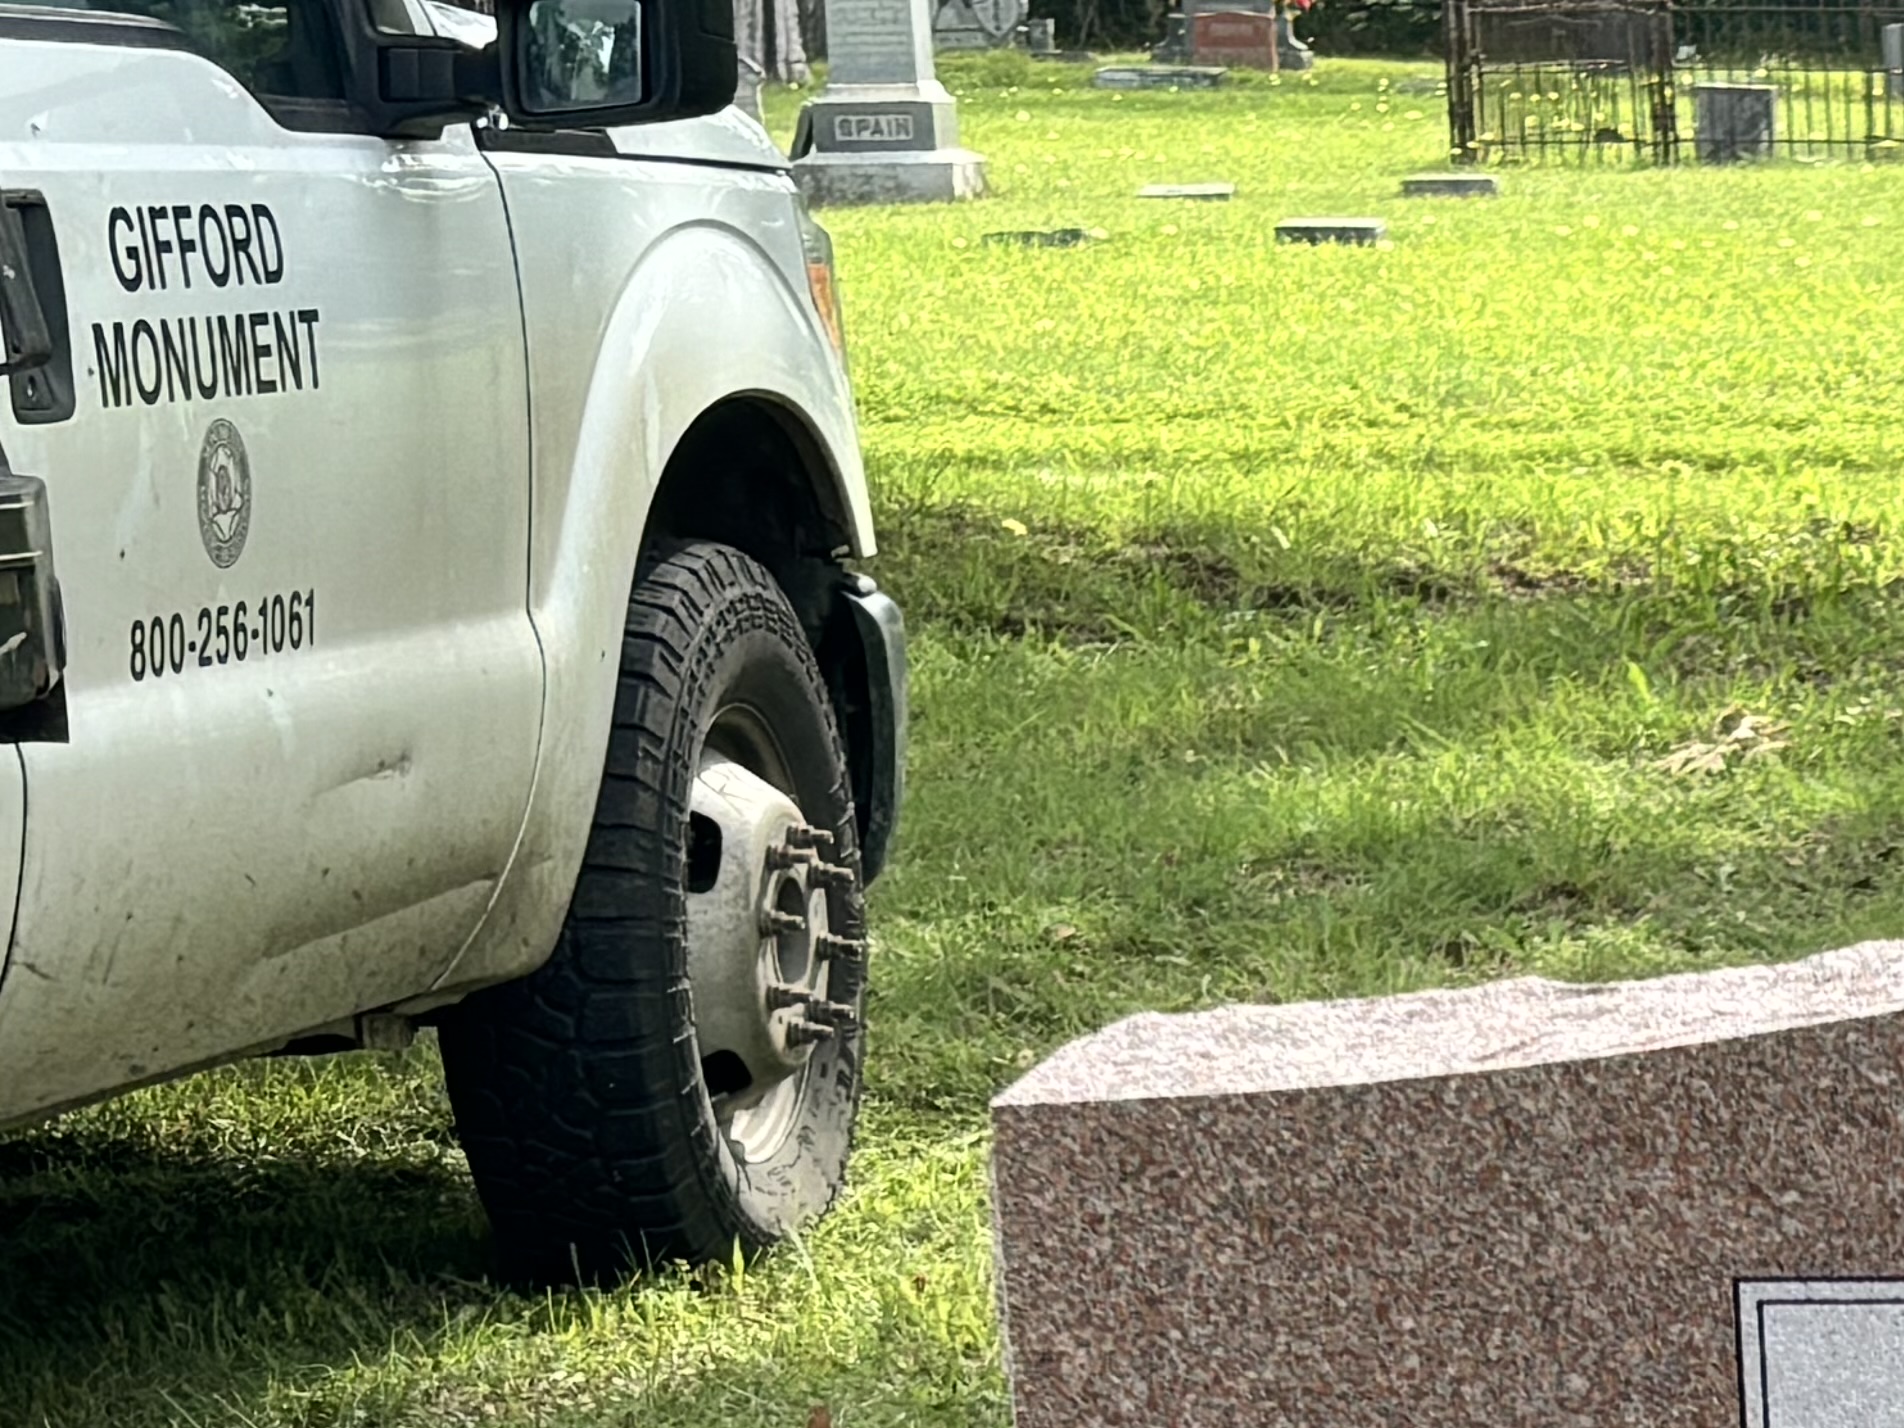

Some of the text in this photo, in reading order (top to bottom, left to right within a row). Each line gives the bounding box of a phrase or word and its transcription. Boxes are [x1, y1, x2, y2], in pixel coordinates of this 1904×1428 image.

[837, 117, 911, 138] SPAIN
[108, 203, 284, 293] GIFFORD
[91, 309, 319, 408] MONUMENT
[130, 589, 314, 682] 800-256-1061
